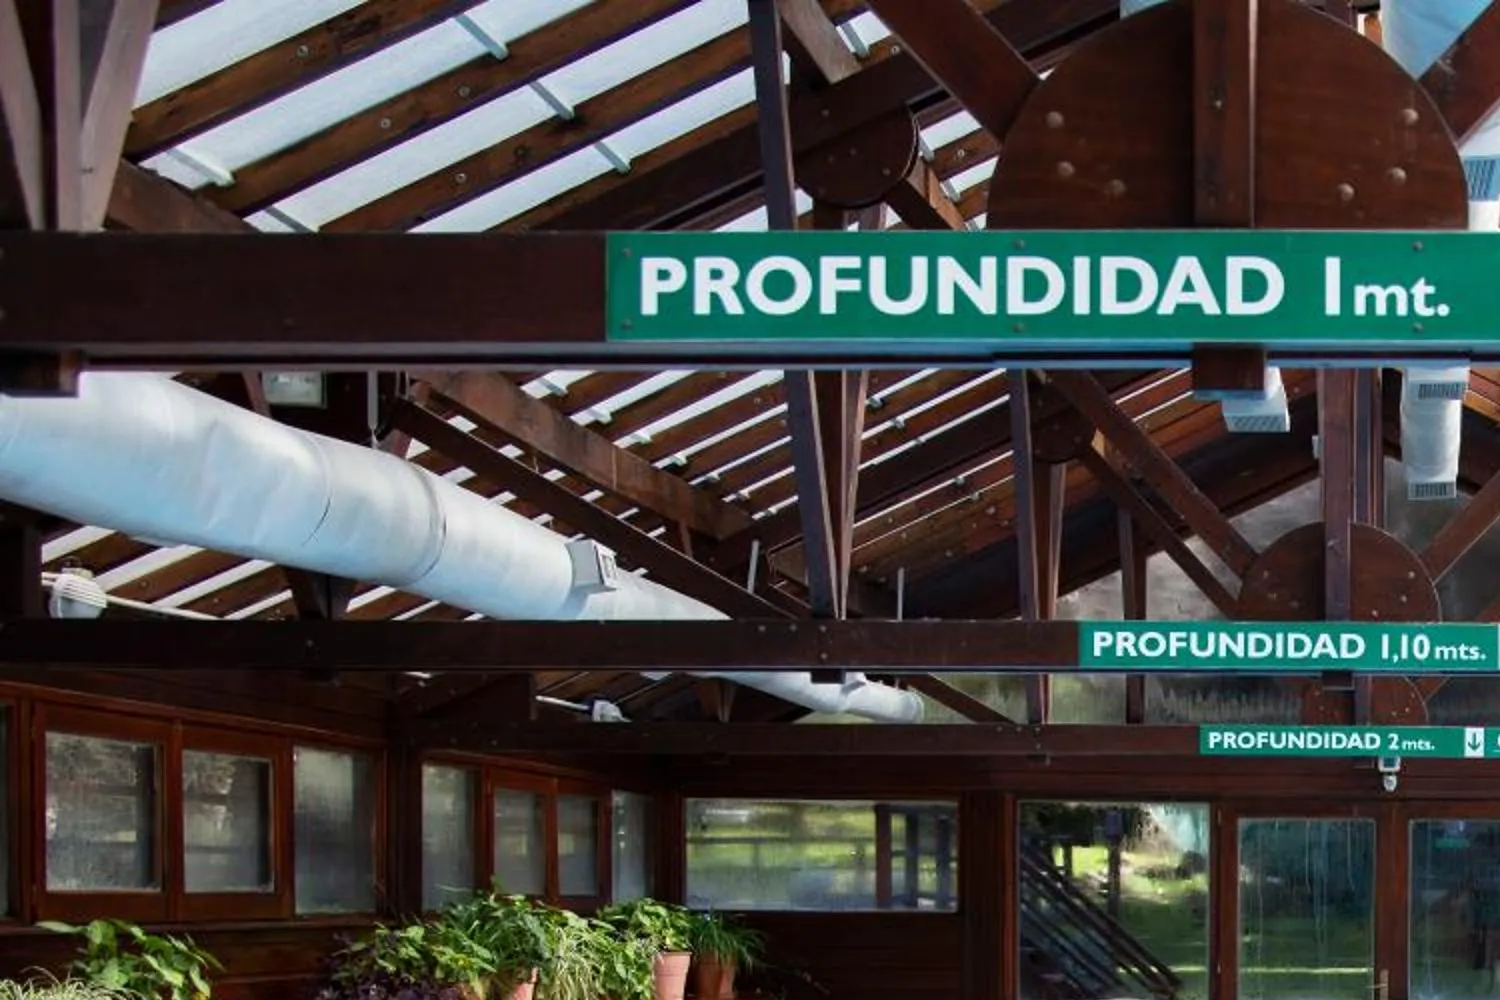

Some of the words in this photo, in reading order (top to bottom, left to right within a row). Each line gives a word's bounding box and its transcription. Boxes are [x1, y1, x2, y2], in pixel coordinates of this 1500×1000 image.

[640, 255, 1286, 316] PROFUNDIDAD
[1093, 631, 1366, 659] PROFUNDIDAD
[1209, 731, 1381, 750] PROFUNDIDAD
